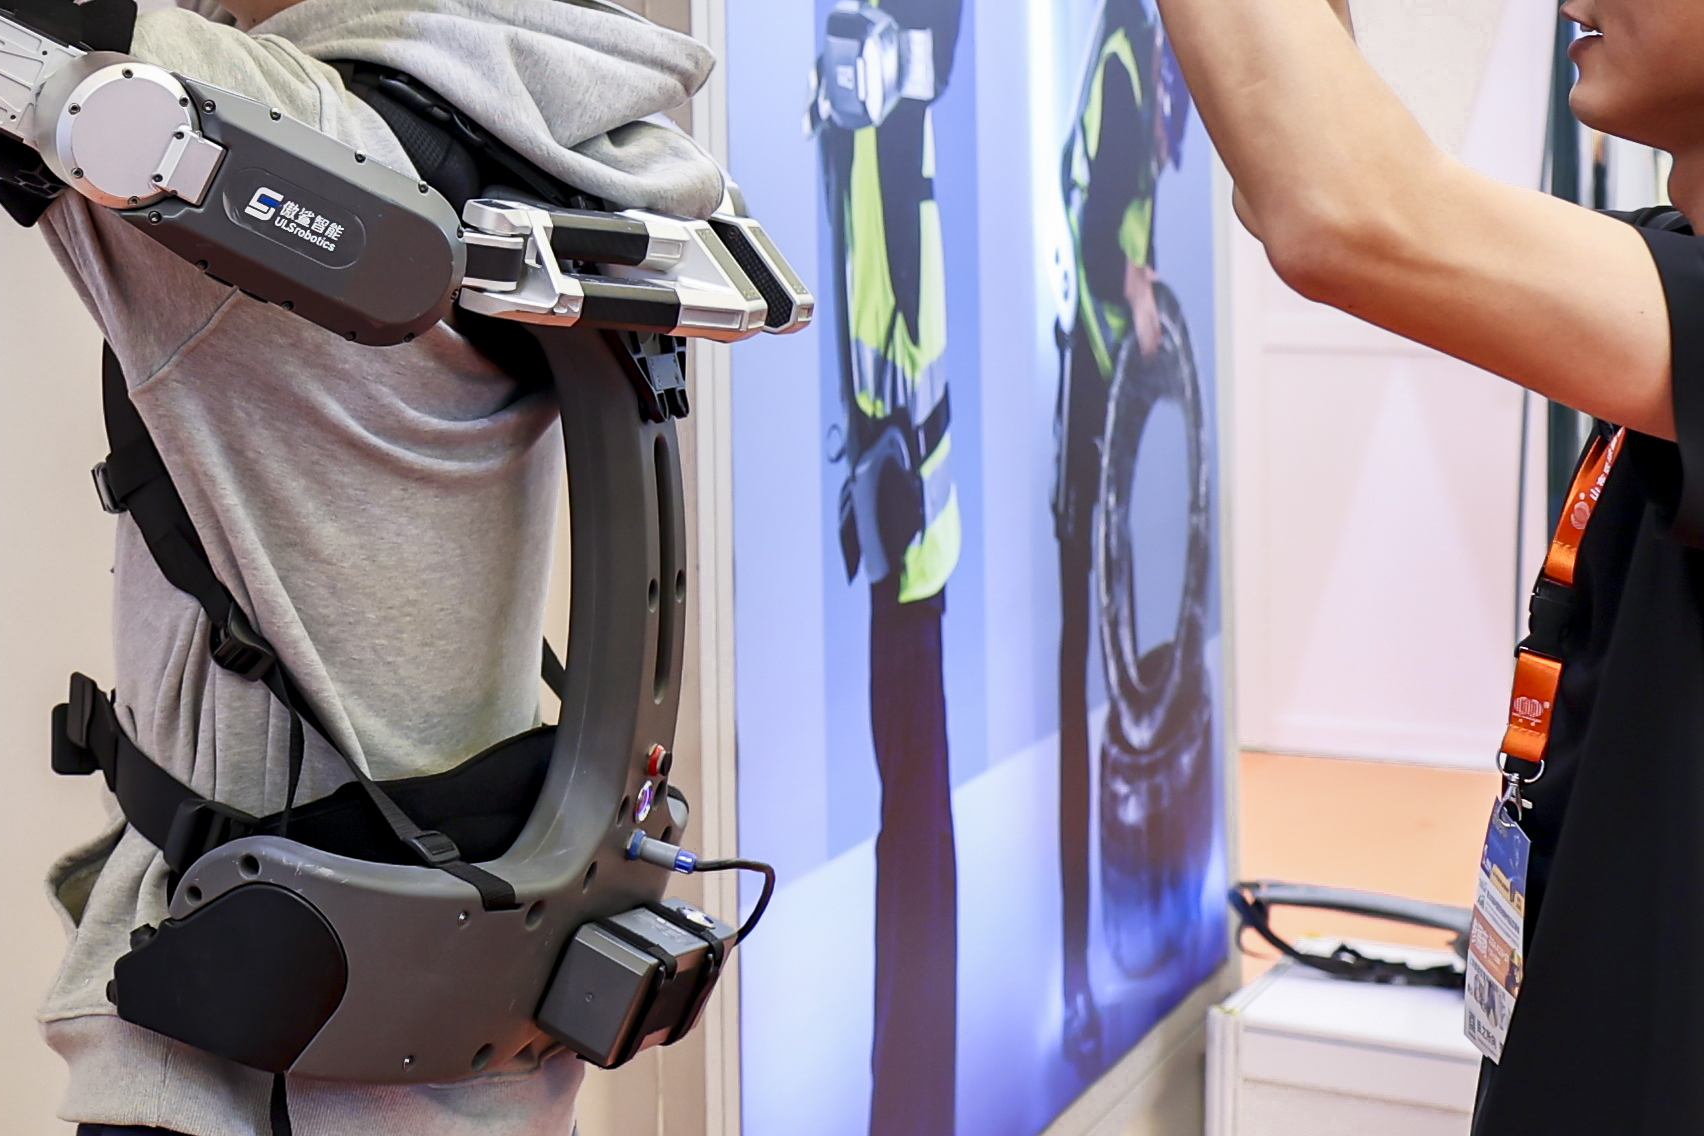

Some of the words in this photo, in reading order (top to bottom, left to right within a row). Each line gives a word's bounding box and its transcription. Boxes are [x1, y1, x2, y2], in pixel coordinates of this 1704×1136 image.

[274, 216, 336, 252] ULSrobotics
[280, 200, 345, 241] 傲鲨智能
